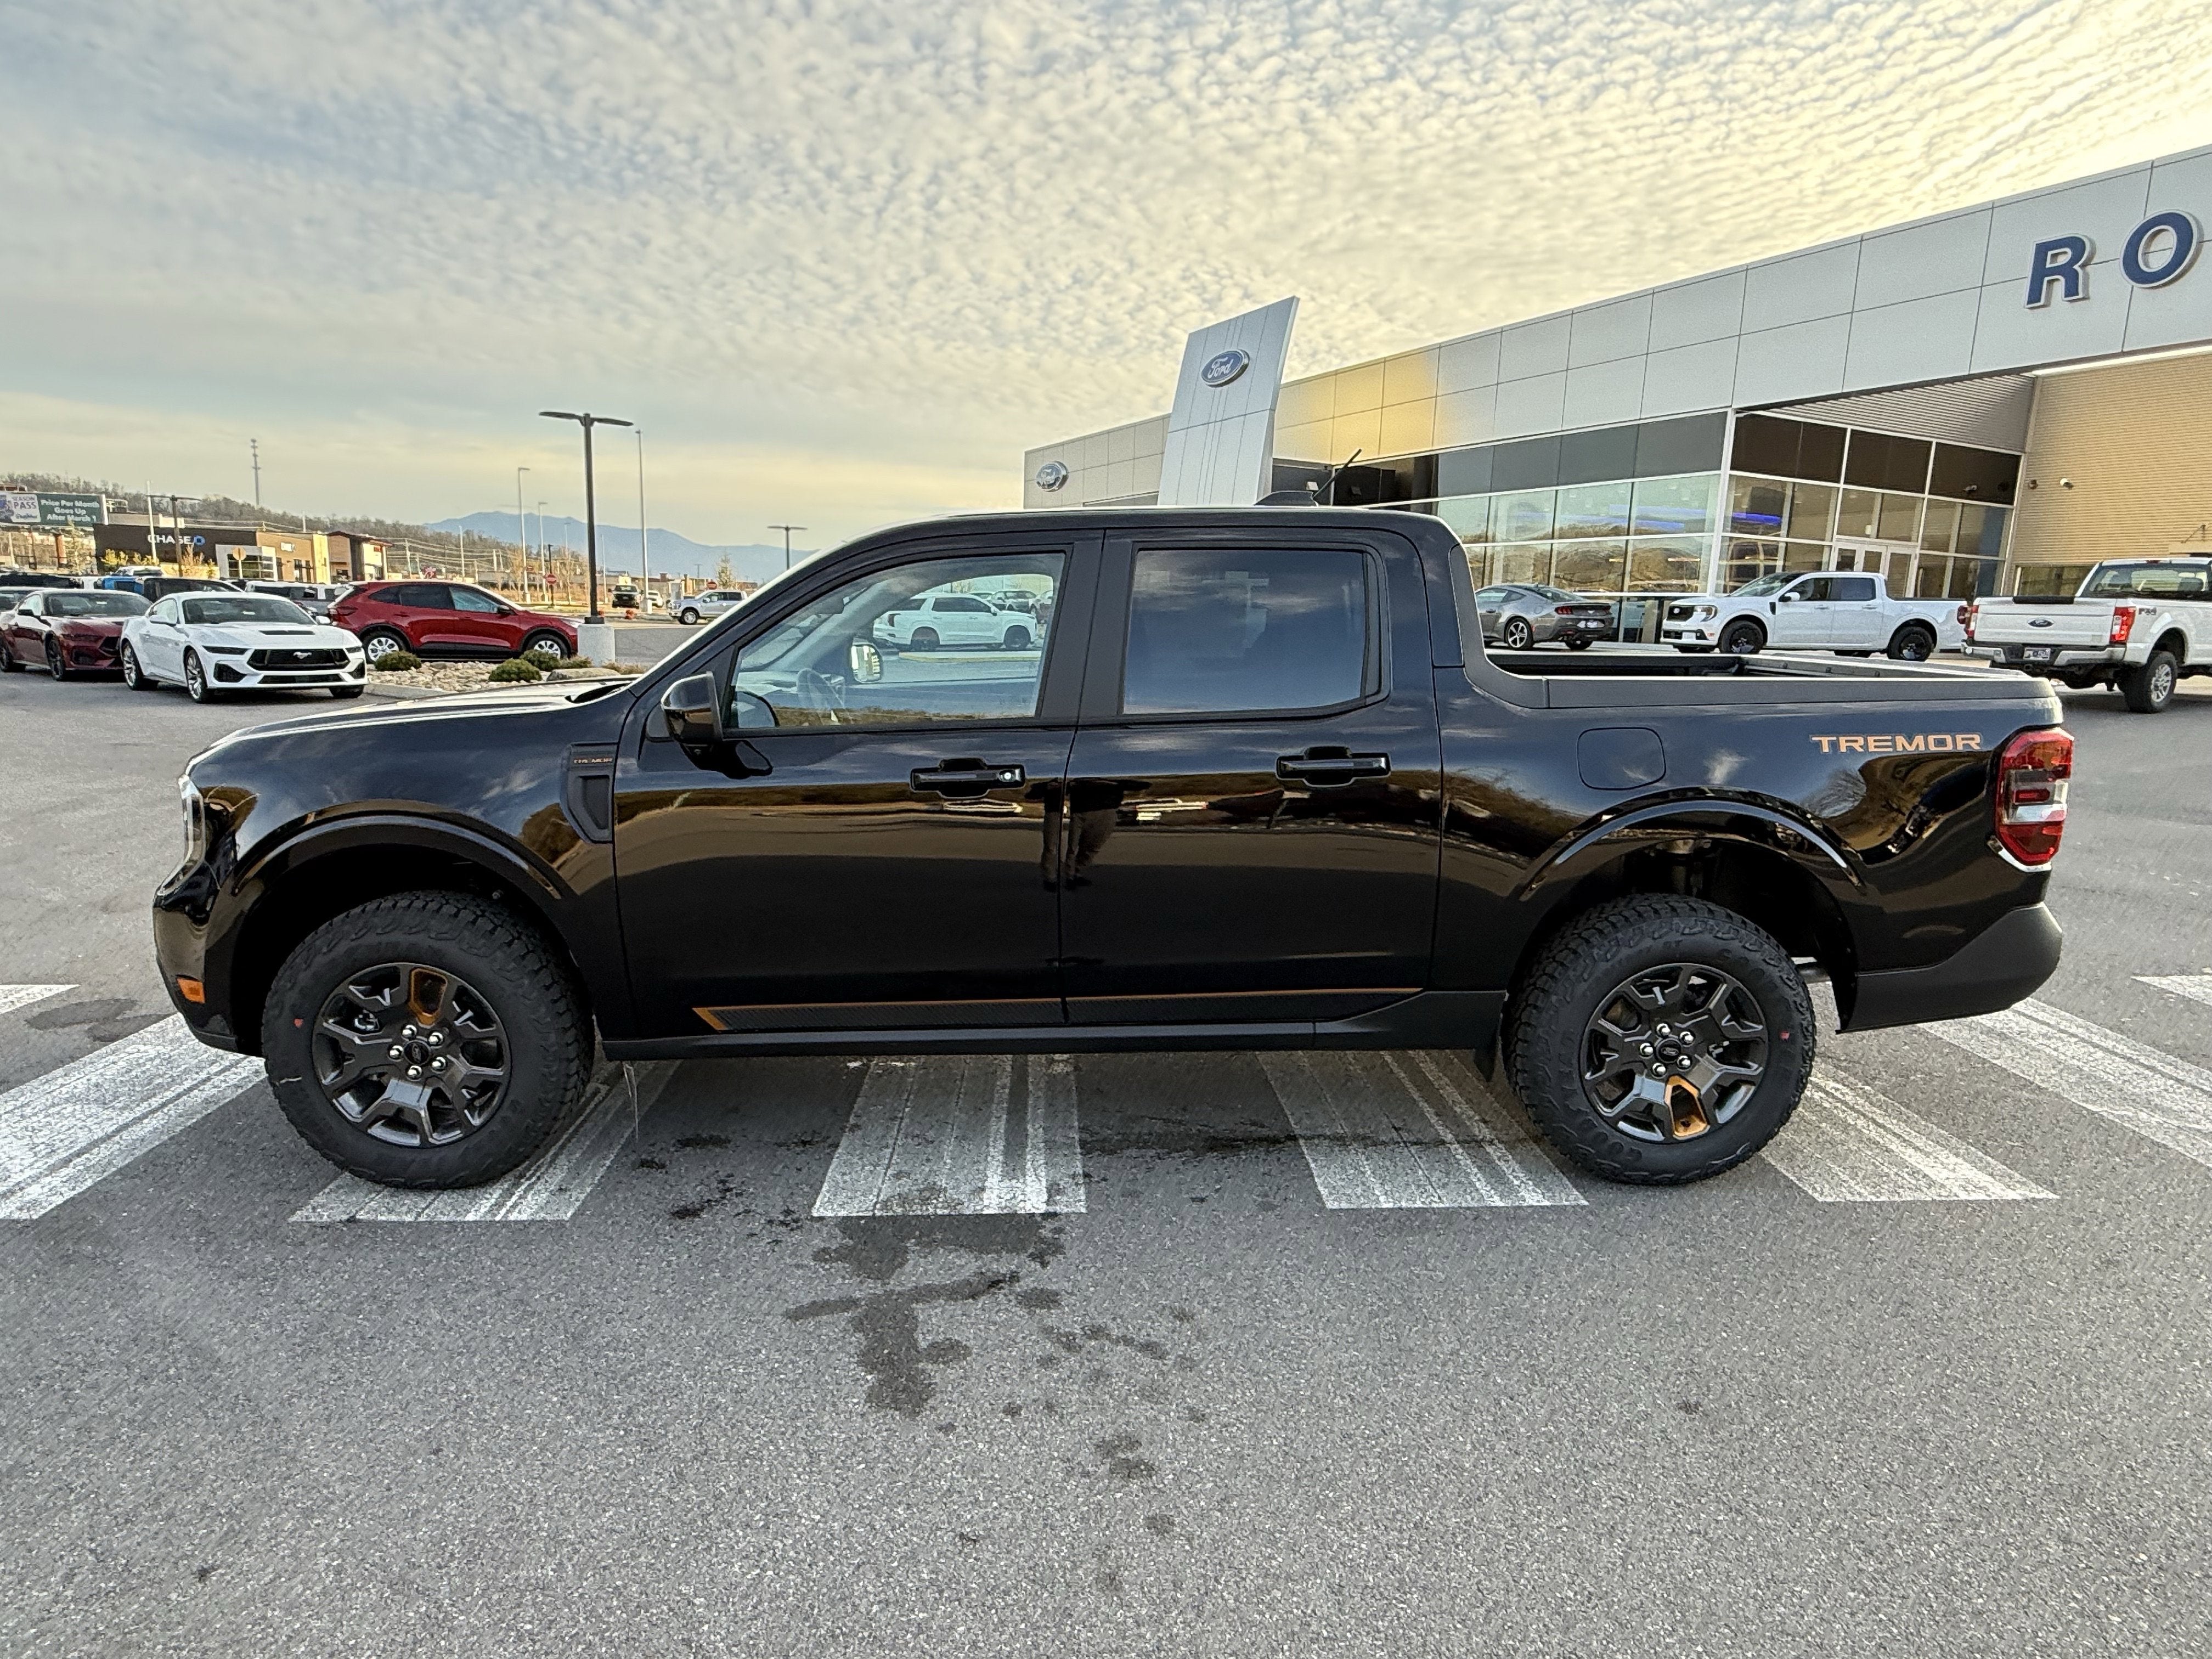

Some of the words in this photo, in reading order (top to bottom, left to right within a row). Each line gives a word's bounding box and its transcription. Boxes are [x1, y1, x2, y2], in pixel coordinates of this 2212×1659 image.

[1207, 357, 1234, 379] Ford
[147, 534, 194, 544] CHASE
[1812, 733, 1981, 754] TREMOR
